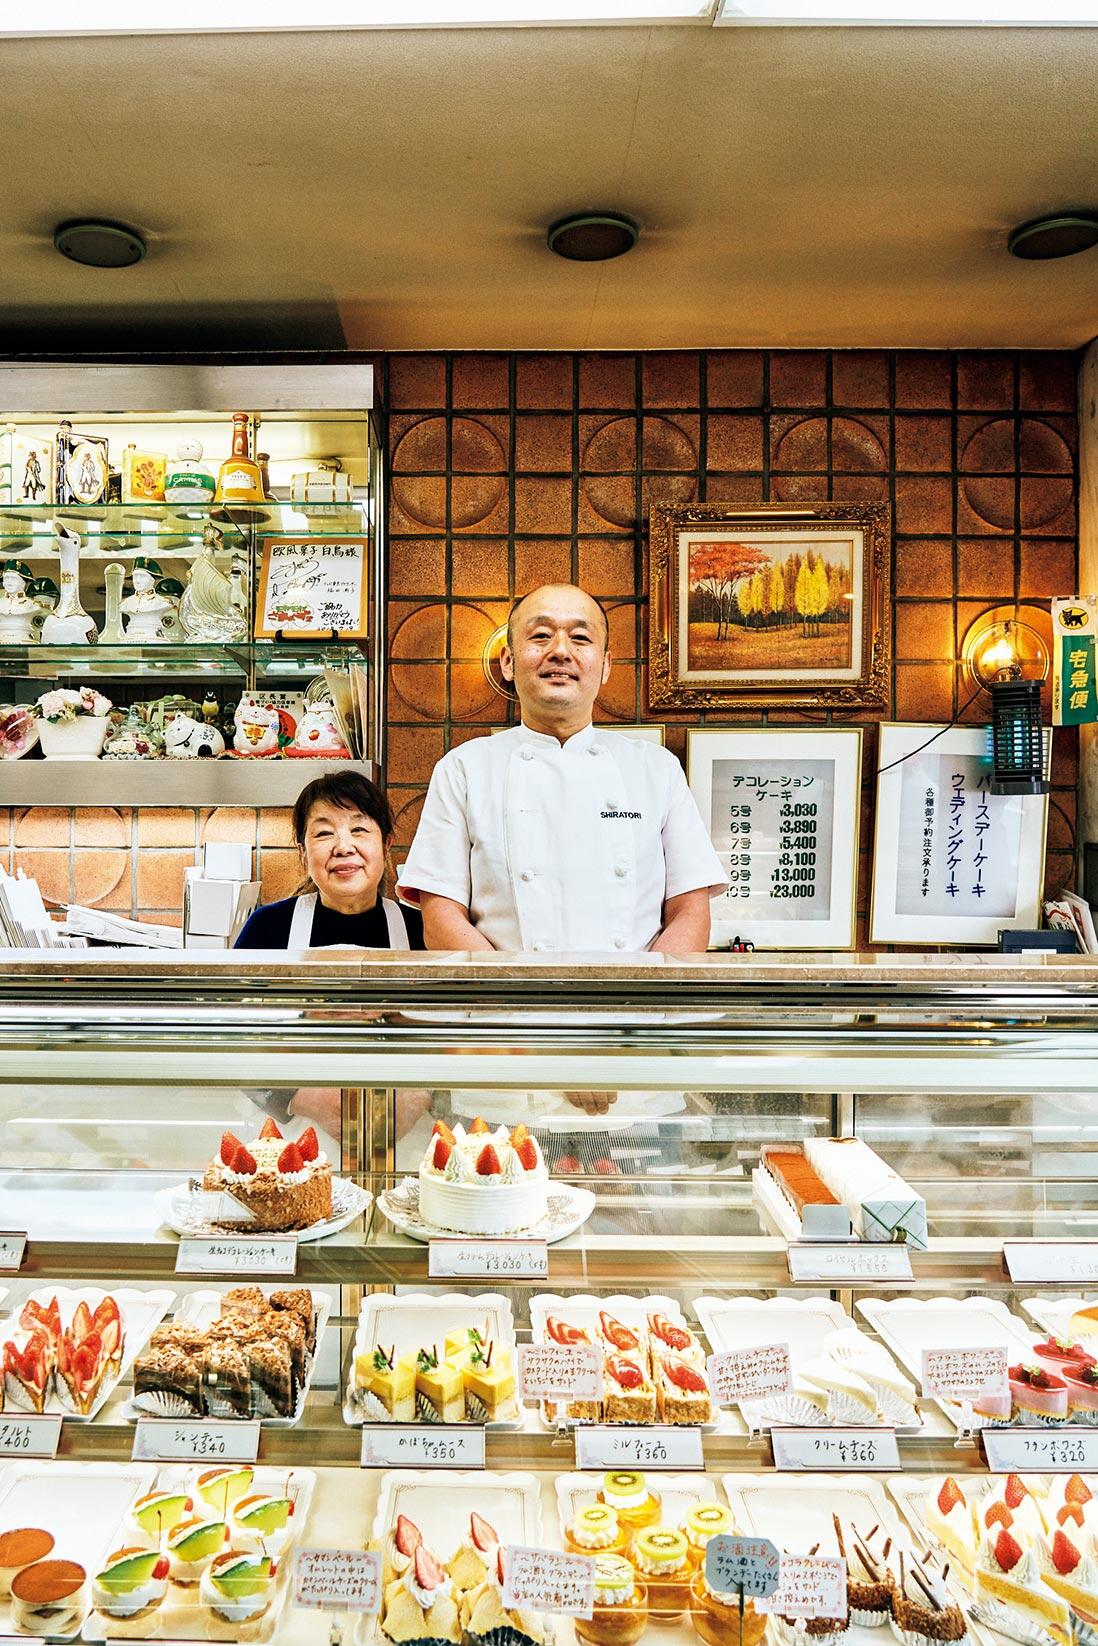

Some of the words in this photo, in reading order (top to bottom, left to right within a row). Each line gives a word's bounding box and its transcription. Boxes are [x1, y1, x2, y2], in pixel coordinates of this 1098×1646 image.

[1069, 650, 1089, 710] 宅急便
[733, 776, 814, 787] デコレーション
[756, 790, 792, 801] ケーキ
[600, 811, 642, 819] SHIRATORI
[730, 805, 752, 817] 5号
[780, 803, 817, 817] ¥3,030
[730, 822, 752, 834] 6号
[779, 820, 817, 834] ¥3,890
[731, 838, 751, 849] 7号
[779, 836, 817, 850] ¥5,400
[921, 788, 935, 897] 各種御予約注文承ります
[730, 854, 751, 866] 8号
[779, 852, 816, 866] ¥8,100
[730, 869, 751, 881] 9号
[771, 867, 815, 881] ¥13,000
[770, 884, 815, 898] ¥23,000
[0, 1436, 29, 1448] 400
[192, 1441, 225, 1454] ¥340
[399, 1437, 465, 1448] かぼちゃムース
[613, 1439, 665, 1449] ミルフィーユ
[815, 1440, 877, 1450] クリームチーズ
[424, 1447, 455, 1458] ¥350
[636, 1448, 667, 1459] ¥360
[840, 1450, 875, 1462] ¥360
[1050, 1450, 1085, 1462] ¥320
